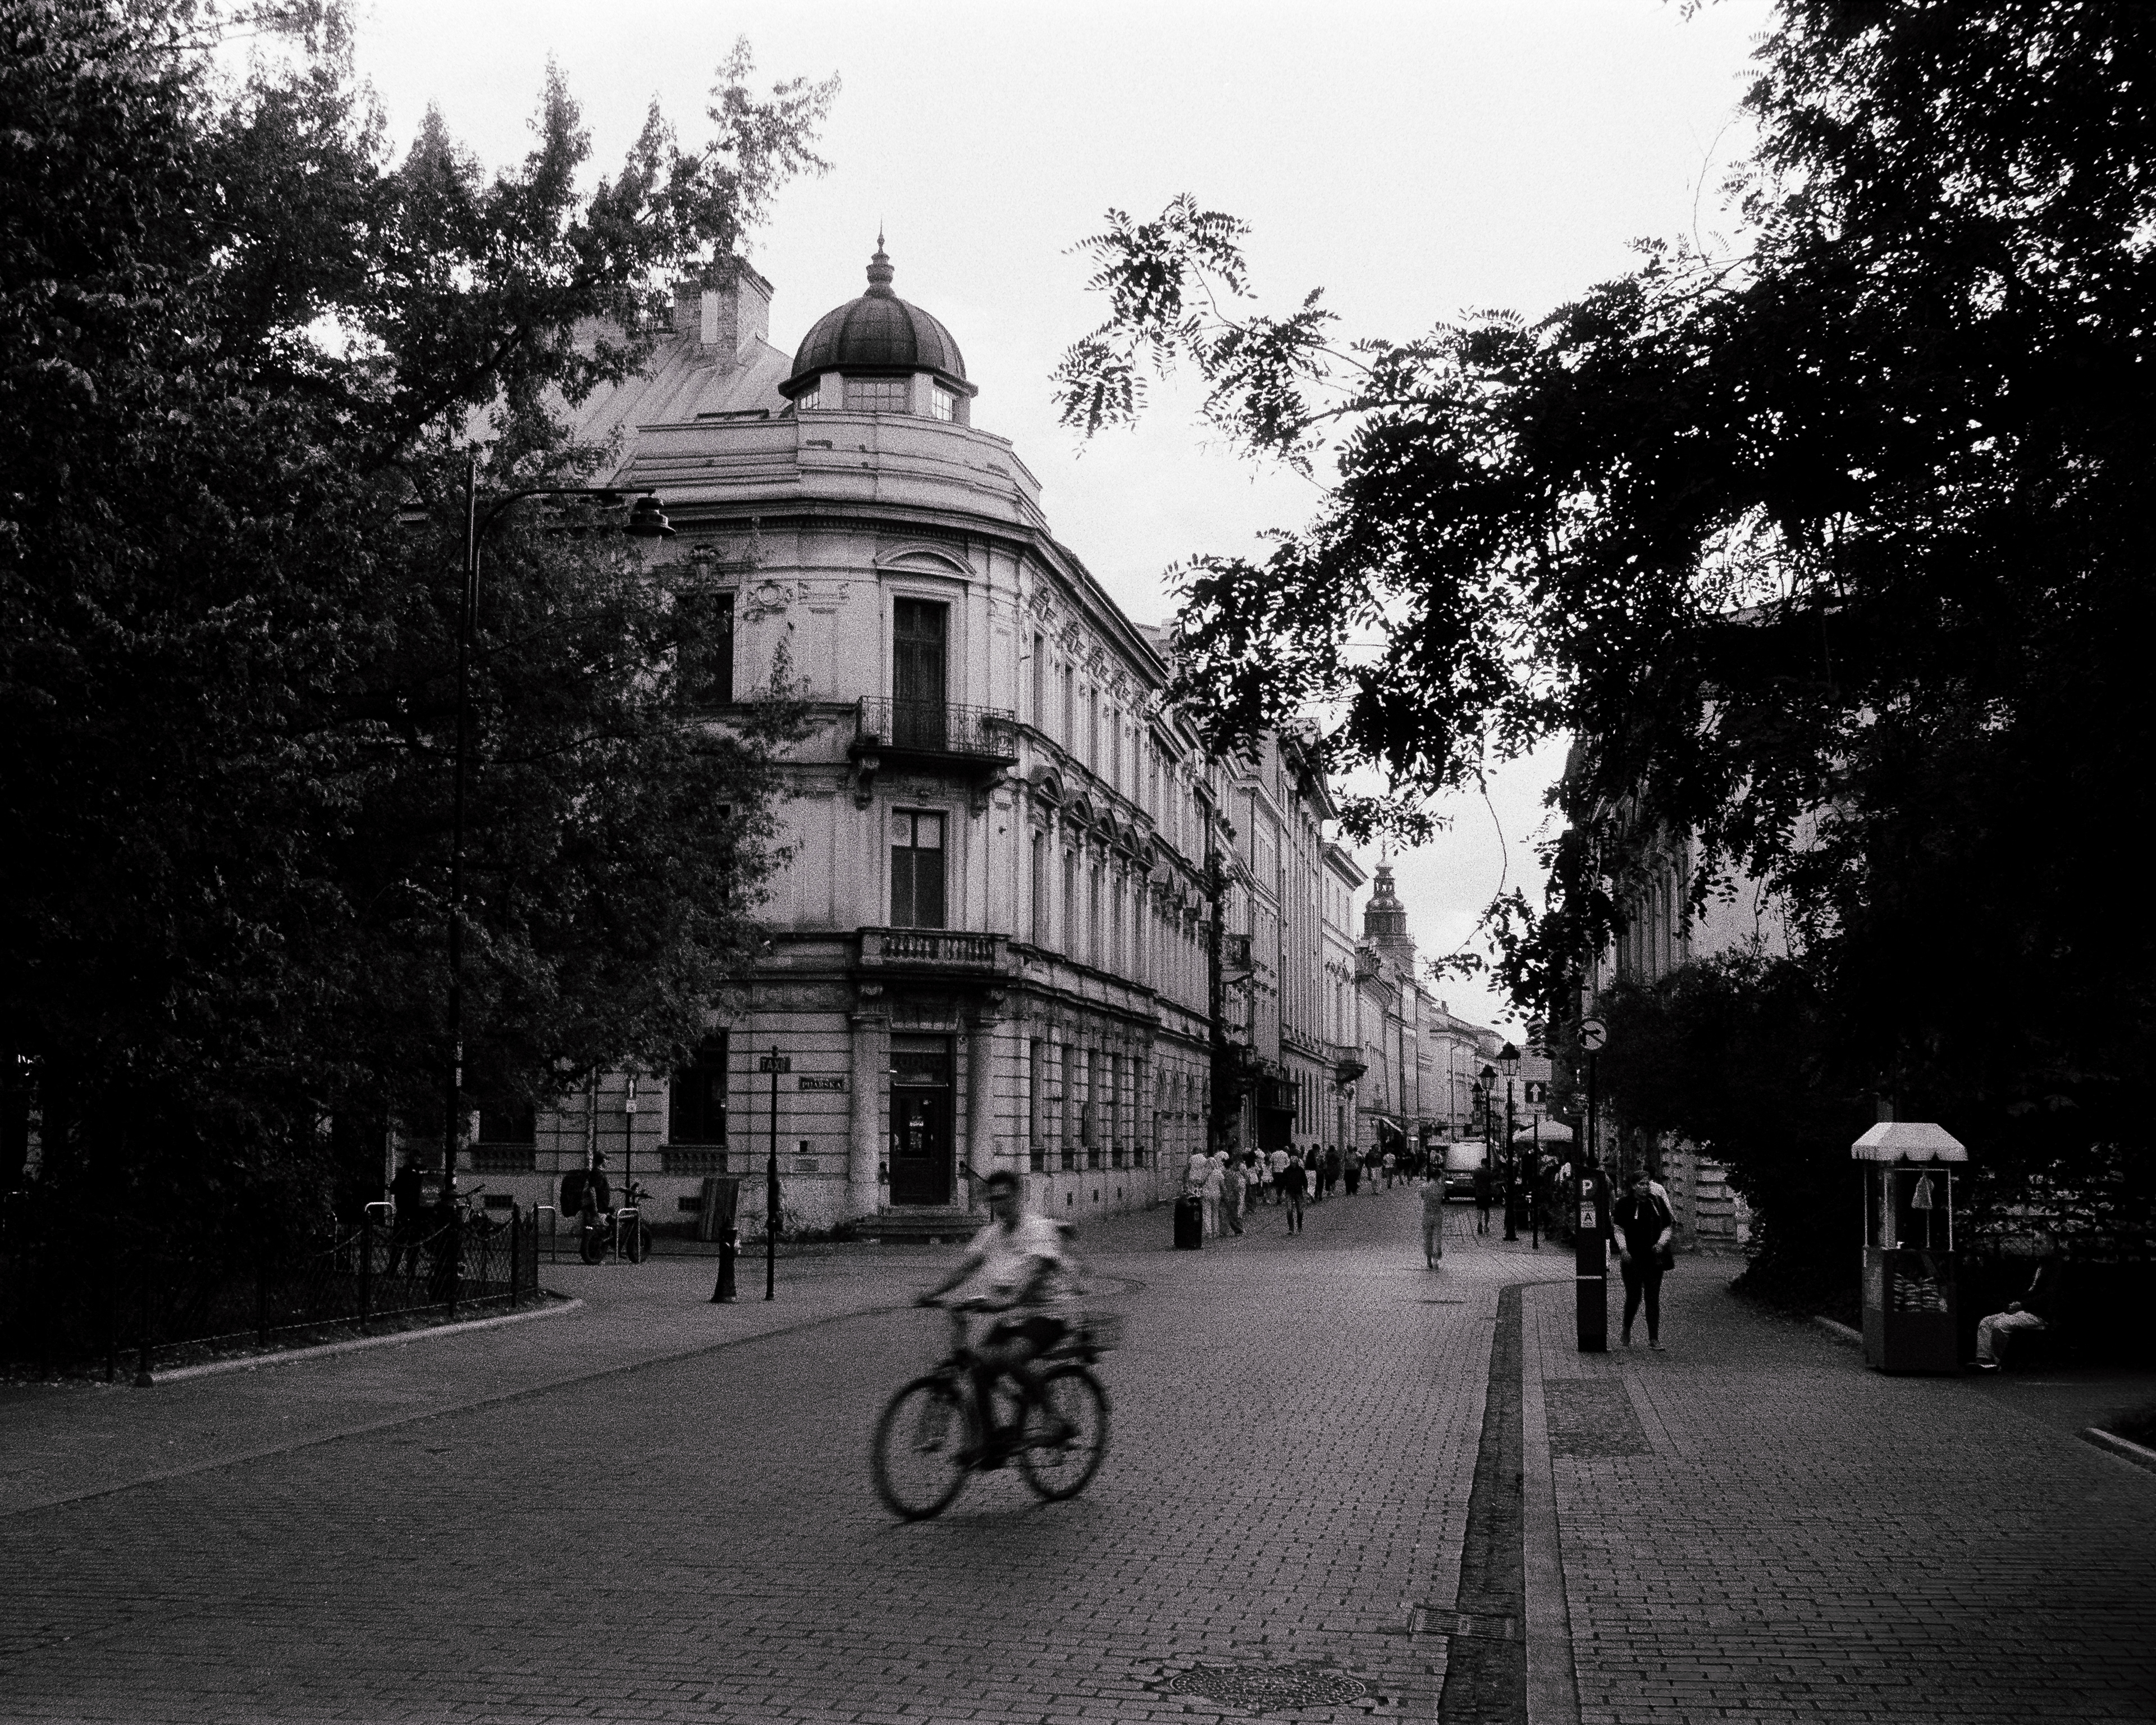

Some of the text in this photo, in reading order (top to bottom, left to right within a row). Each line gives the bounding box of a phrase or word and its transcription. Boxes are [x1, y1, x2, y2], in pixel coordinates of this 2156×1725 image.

[761, 1059, 783, 1071] TAXI
[1582, 1179, 1593, 1196] P
[1584, 1212, 1593, 1222] A
